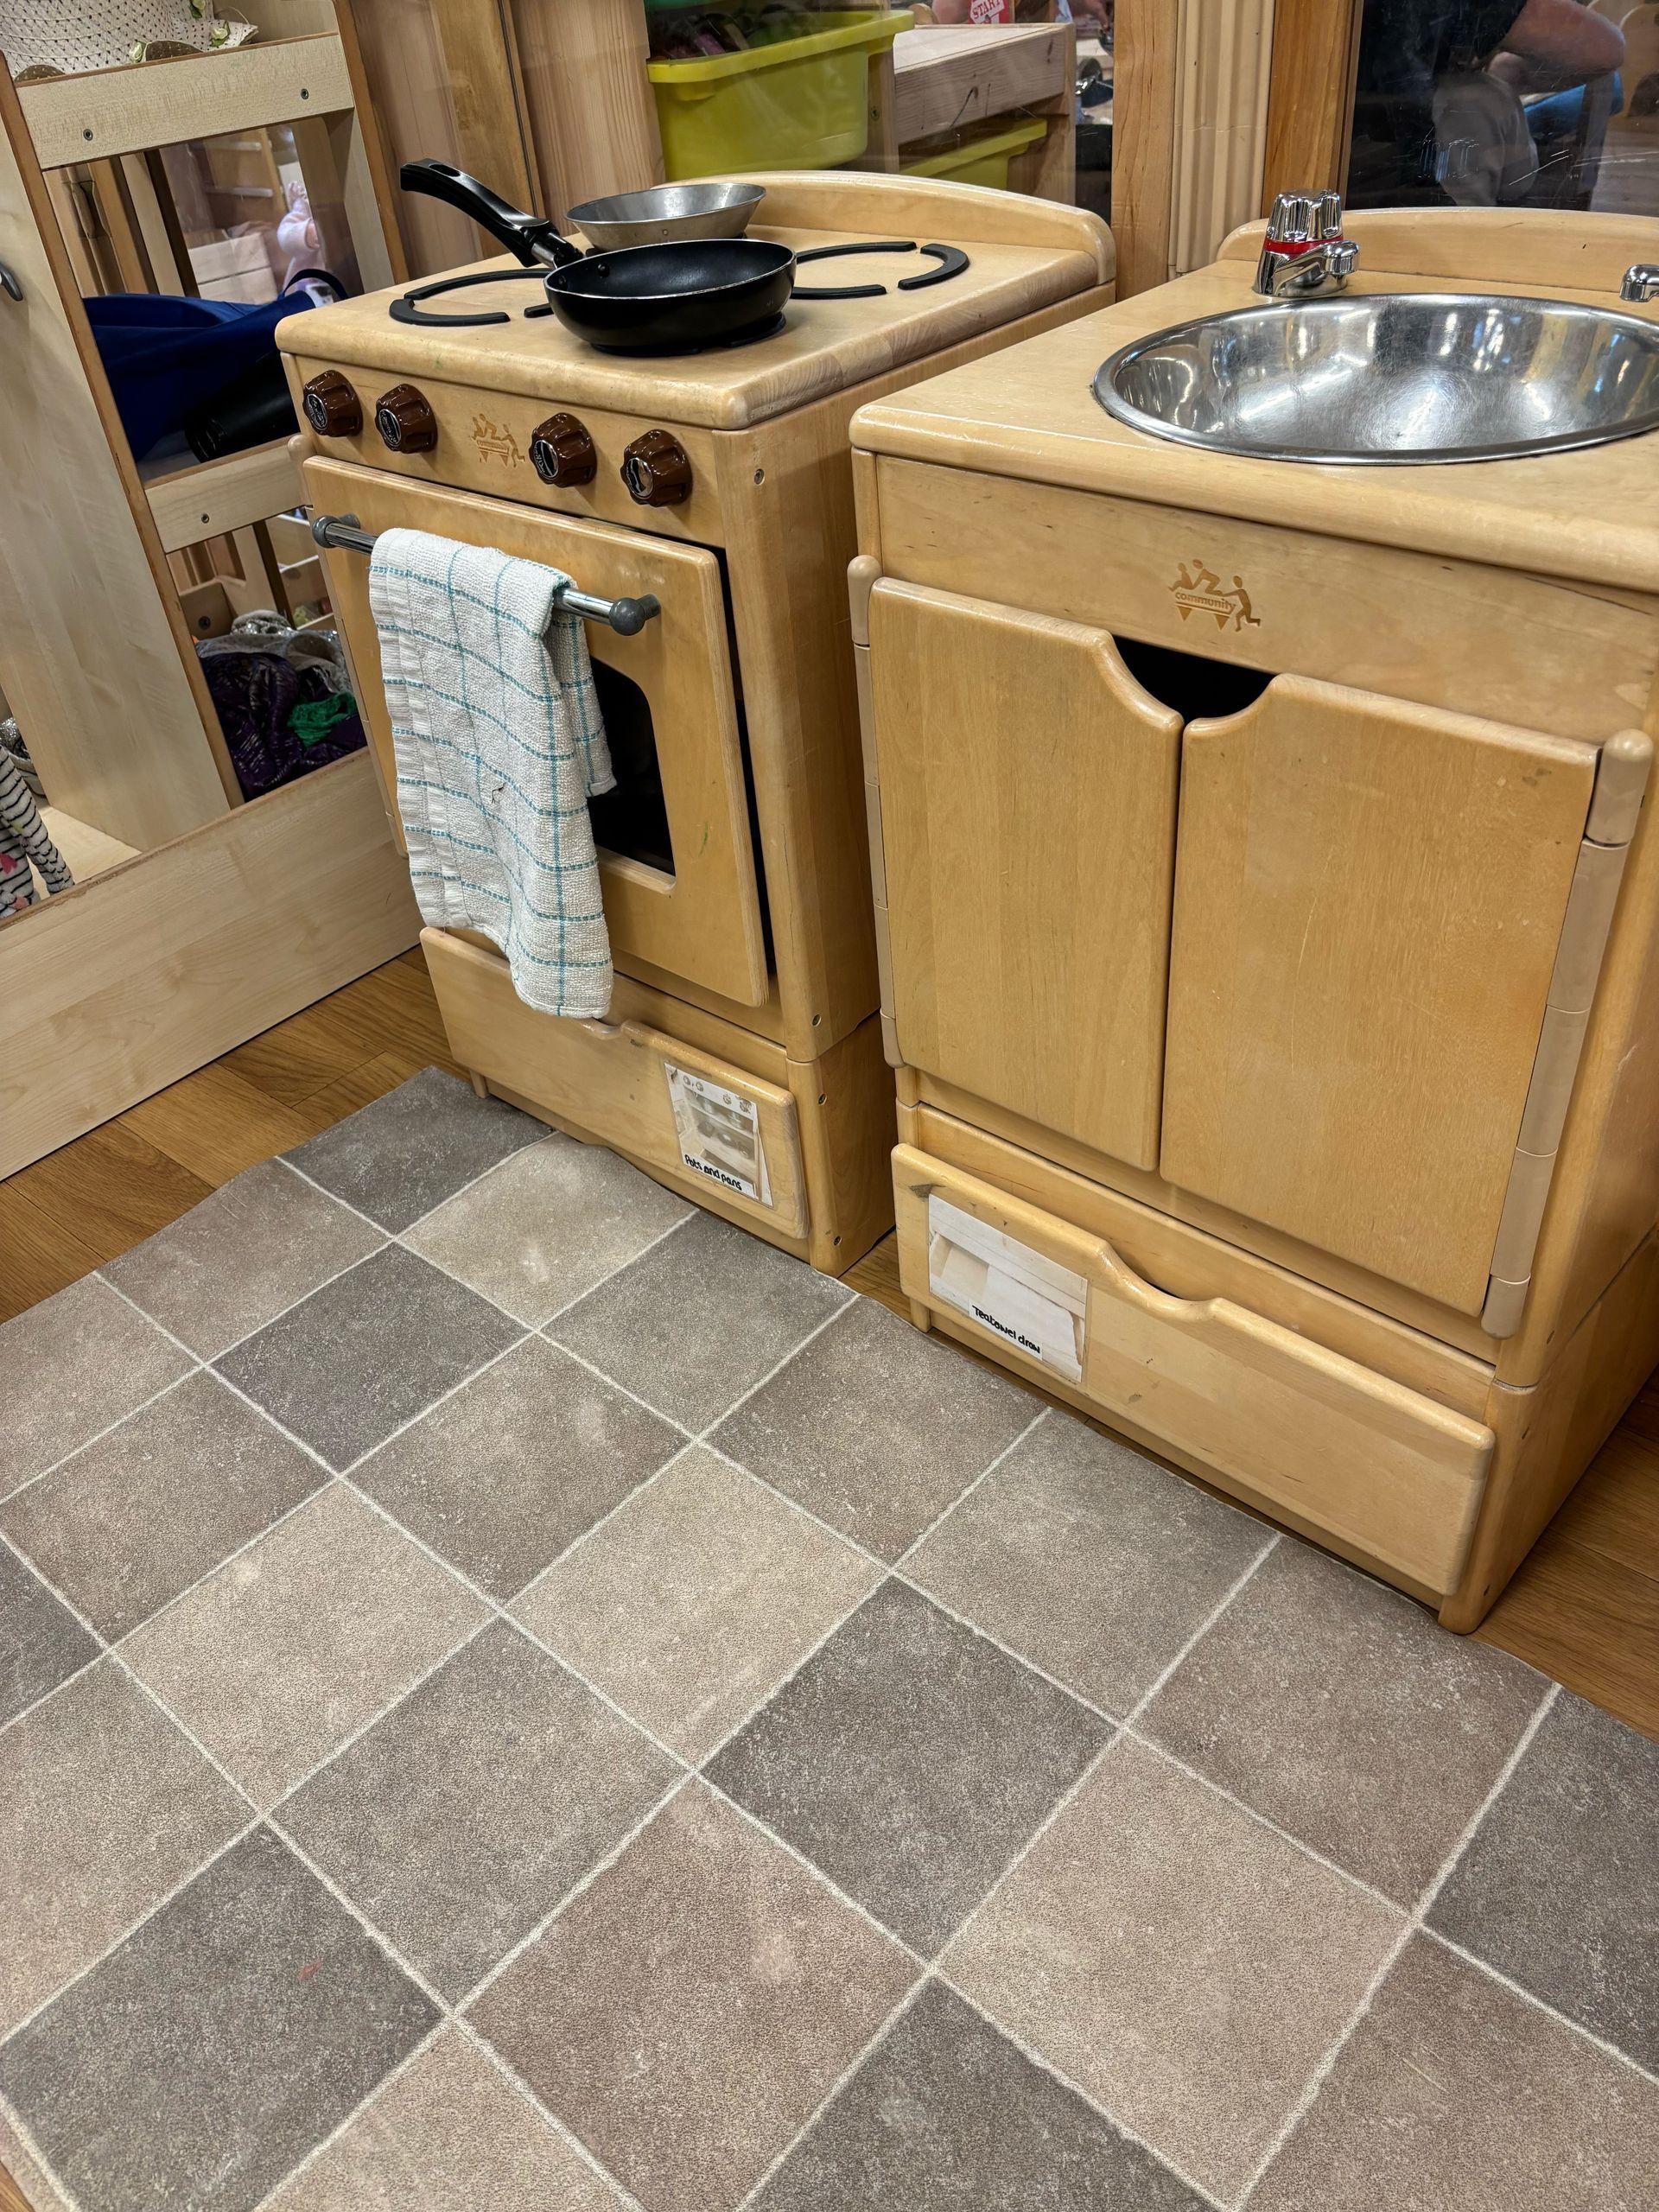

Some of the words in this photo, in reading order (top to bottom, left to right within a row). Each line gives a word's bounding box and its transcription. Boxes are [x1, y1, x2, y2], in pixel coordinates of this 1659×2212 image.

[1174, 591, 1236, 613] community
[684, 1154, 702, 1171] Pots
[703, 1165, 721, 1179] and
[721, 1173, 742, 1191] pans
[971, 1305, 1017, 1339] Teatowel
[1018, 1334, 1041, 1353] draw
